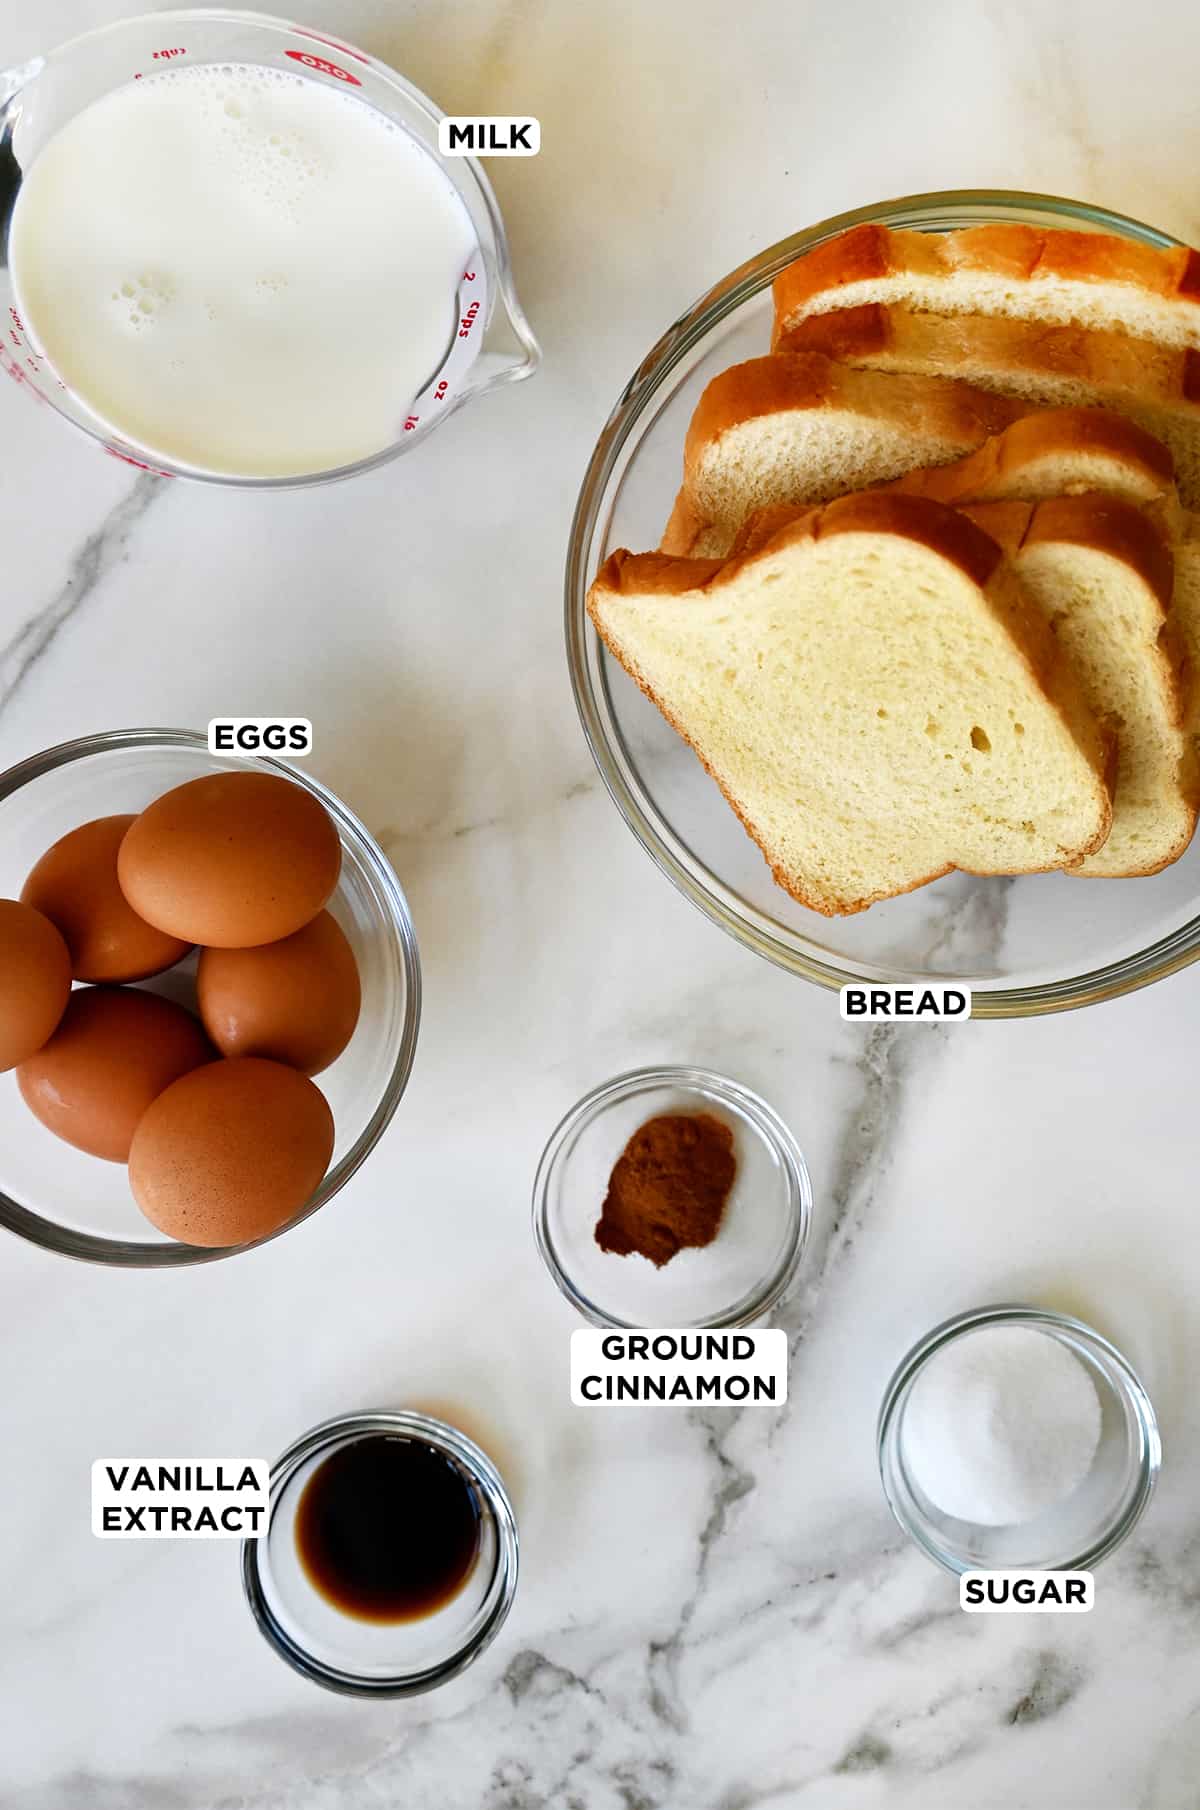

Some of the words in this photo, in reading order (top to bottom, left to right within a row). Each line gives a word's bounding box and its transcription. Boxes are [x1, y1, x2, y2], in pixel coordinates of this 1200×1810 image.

[300, 54, 348, 79] OXO
[462, 271, 477, 282] 2
[458, 300, 481, 338] cups
[433, 380, 449, 400] oz
[402, 415, 419, 431] 16
